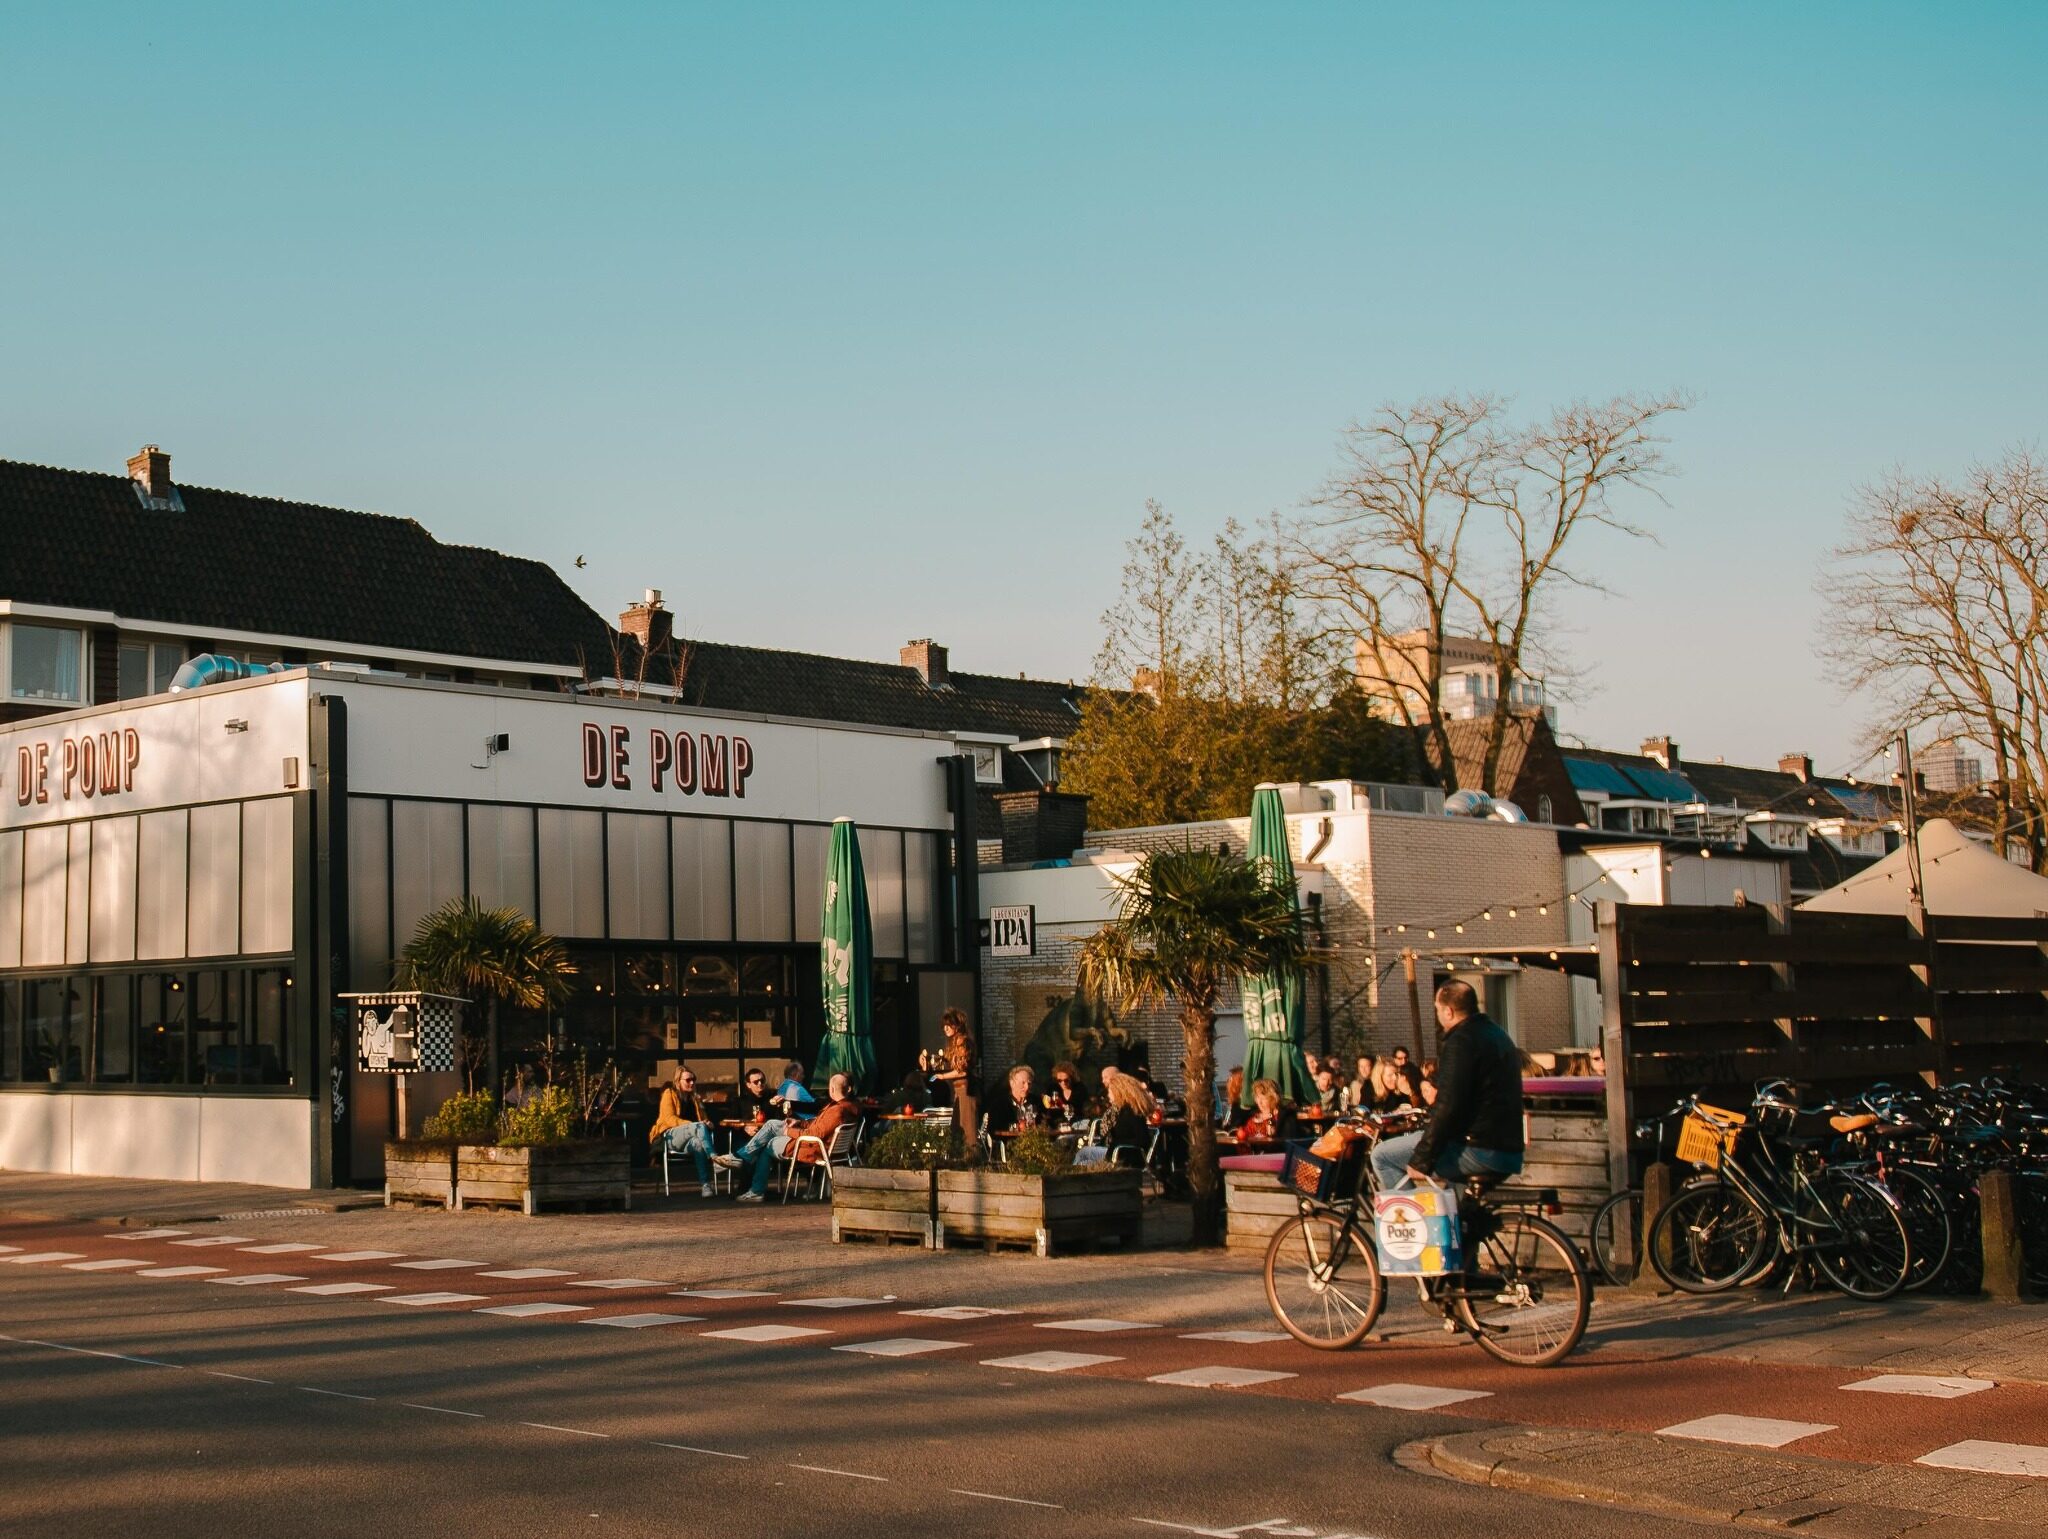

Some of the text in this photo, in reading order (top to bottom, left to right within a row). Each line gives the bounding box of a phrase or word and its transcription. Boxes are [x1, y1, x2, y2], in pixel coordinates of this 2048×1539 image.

[18, 727, 140, 807] DE POMP
[583, 722, 754, 799] DE POMP
[993, 917, 1029, 946] IPA
[1387, 1225, 1416, 1241] Page
